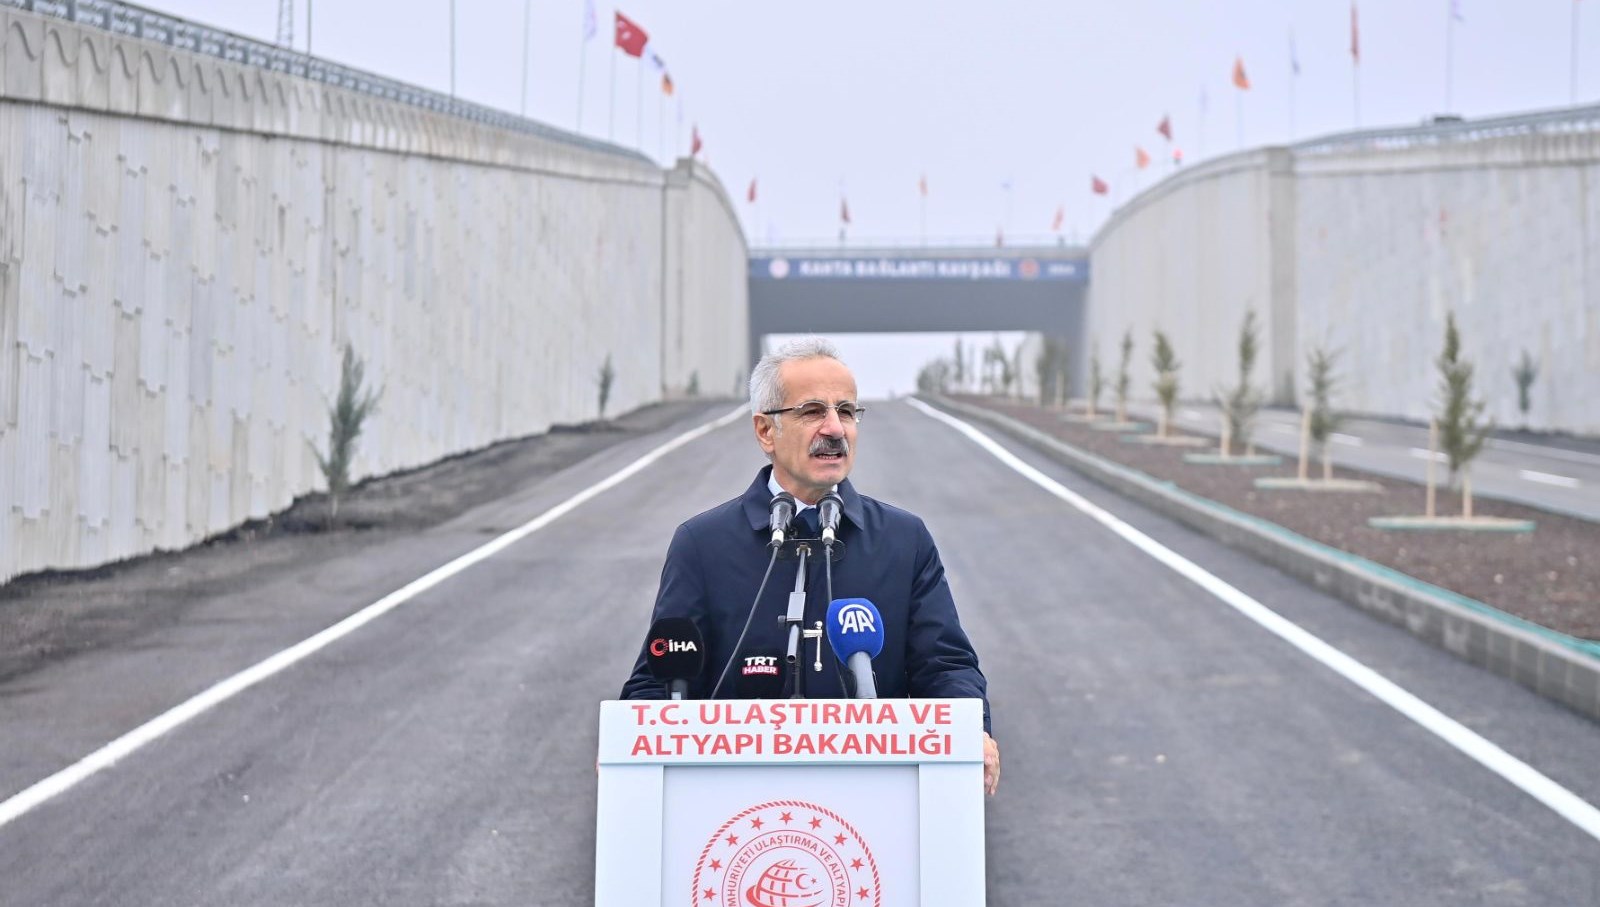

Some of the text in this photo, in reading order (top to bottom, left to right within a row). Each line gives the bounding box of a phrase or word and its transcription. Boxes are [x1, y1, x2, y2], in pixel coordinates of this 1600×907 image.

[841, 610, 876, 635] AA
[743, 666, 777, 675] HABER
[744, 656, 777, 667] TRT
[631, 703, 952, 730] T.C. ULAŞTIRMA VE
[631, 729, 952, 756] ALTYAPI BAKANLIĞI
[754, 834, 818, 852] ULAŞTIRMA
[819, 847, 833, 862] VE
